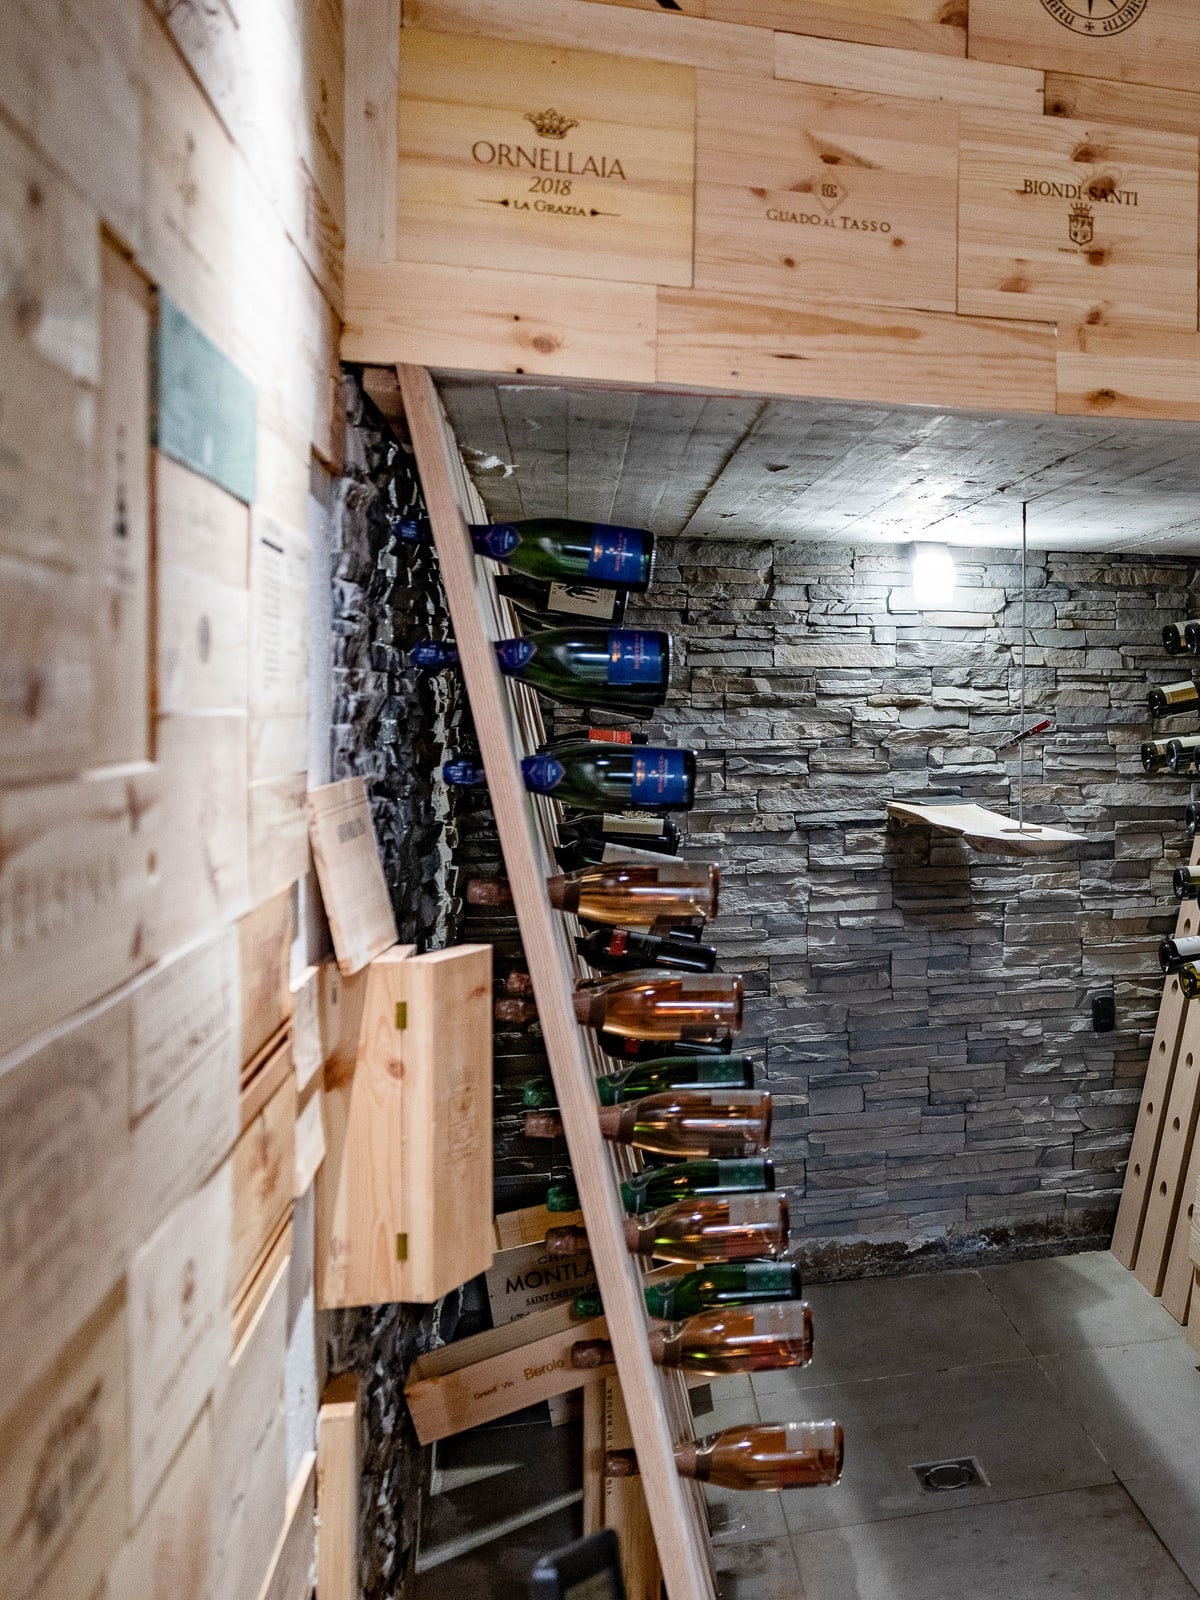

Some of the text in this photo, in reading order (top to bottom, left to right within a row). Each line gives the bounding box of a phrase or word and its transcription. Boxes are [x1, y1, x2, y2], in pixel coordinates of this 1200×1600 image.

[472, 141, 627, 180] ORNELLAIA
[528, 175, 574, 196] 2018
[1023, 179, 1138, 206] BIONDI-SANTI
[514, 200, 586, 216] LA GRAZIA
[766, 208, 821, 225] GUADO
[840, 216, 891, 233] TASSO
